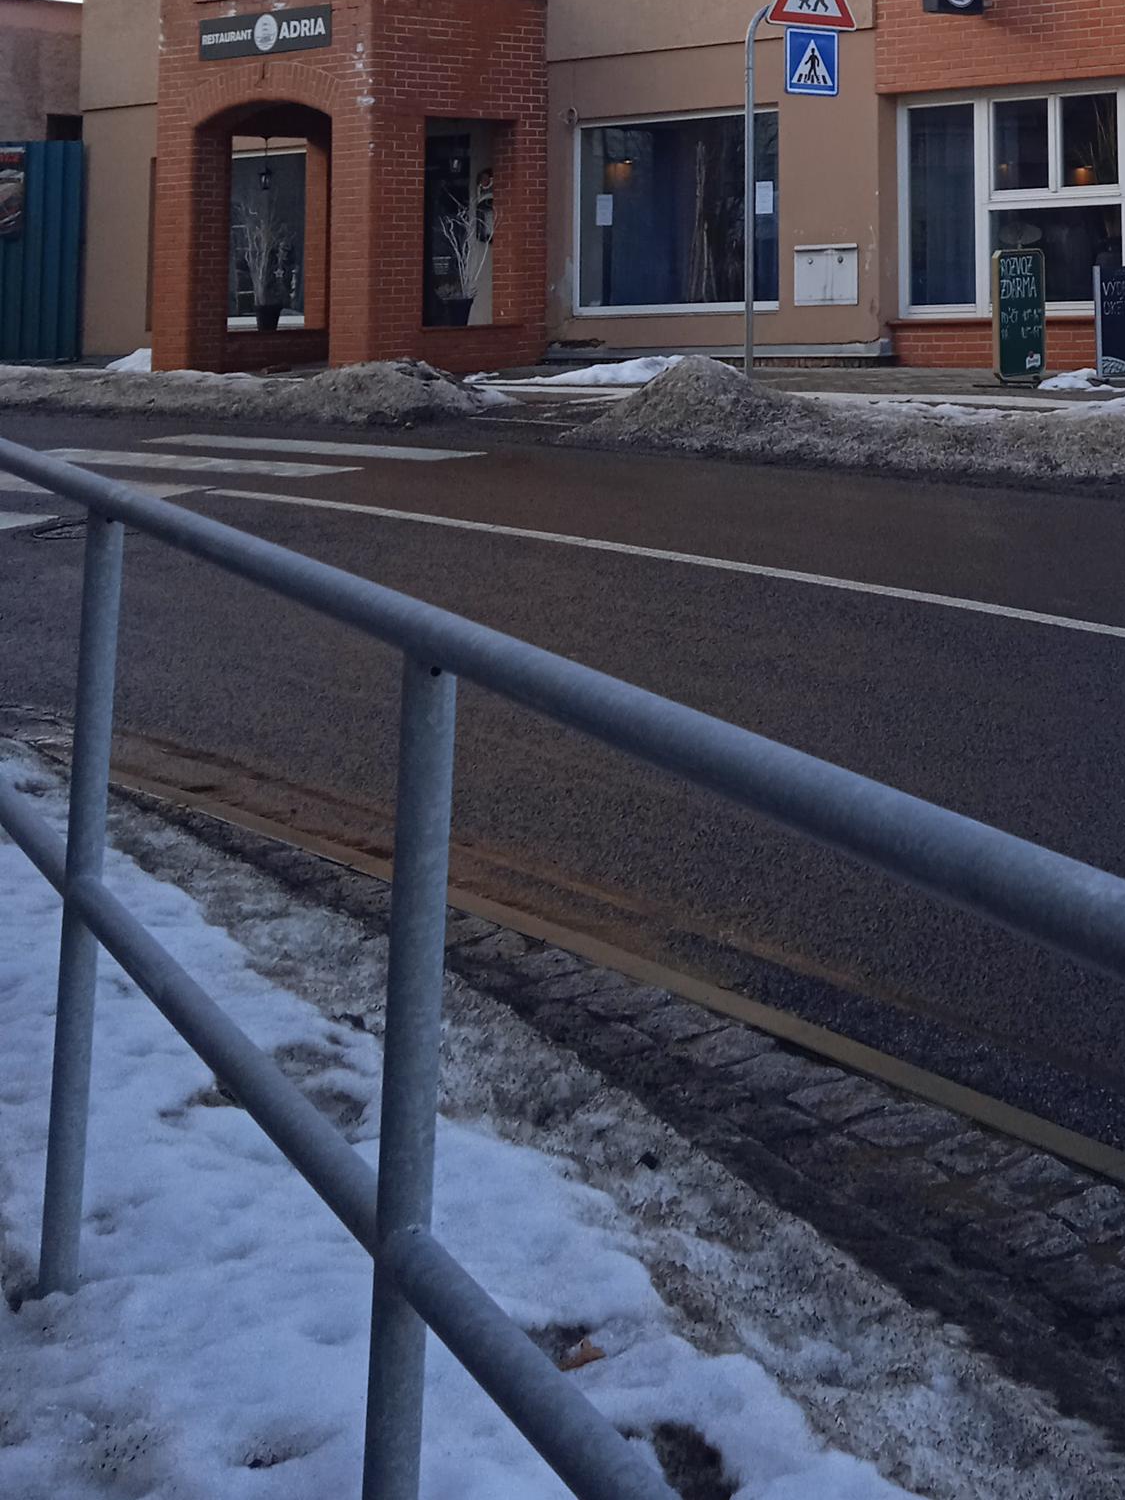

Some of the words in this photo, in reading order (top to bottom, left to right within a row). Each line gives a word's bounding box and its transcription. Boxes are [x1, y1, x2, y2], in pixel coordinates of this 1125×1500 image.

[201, 29, 253, 45] RESTAURANT
[279, 17, 326, 40] ADRIA
[1000, 276, 1038, 299] ZDARMA
